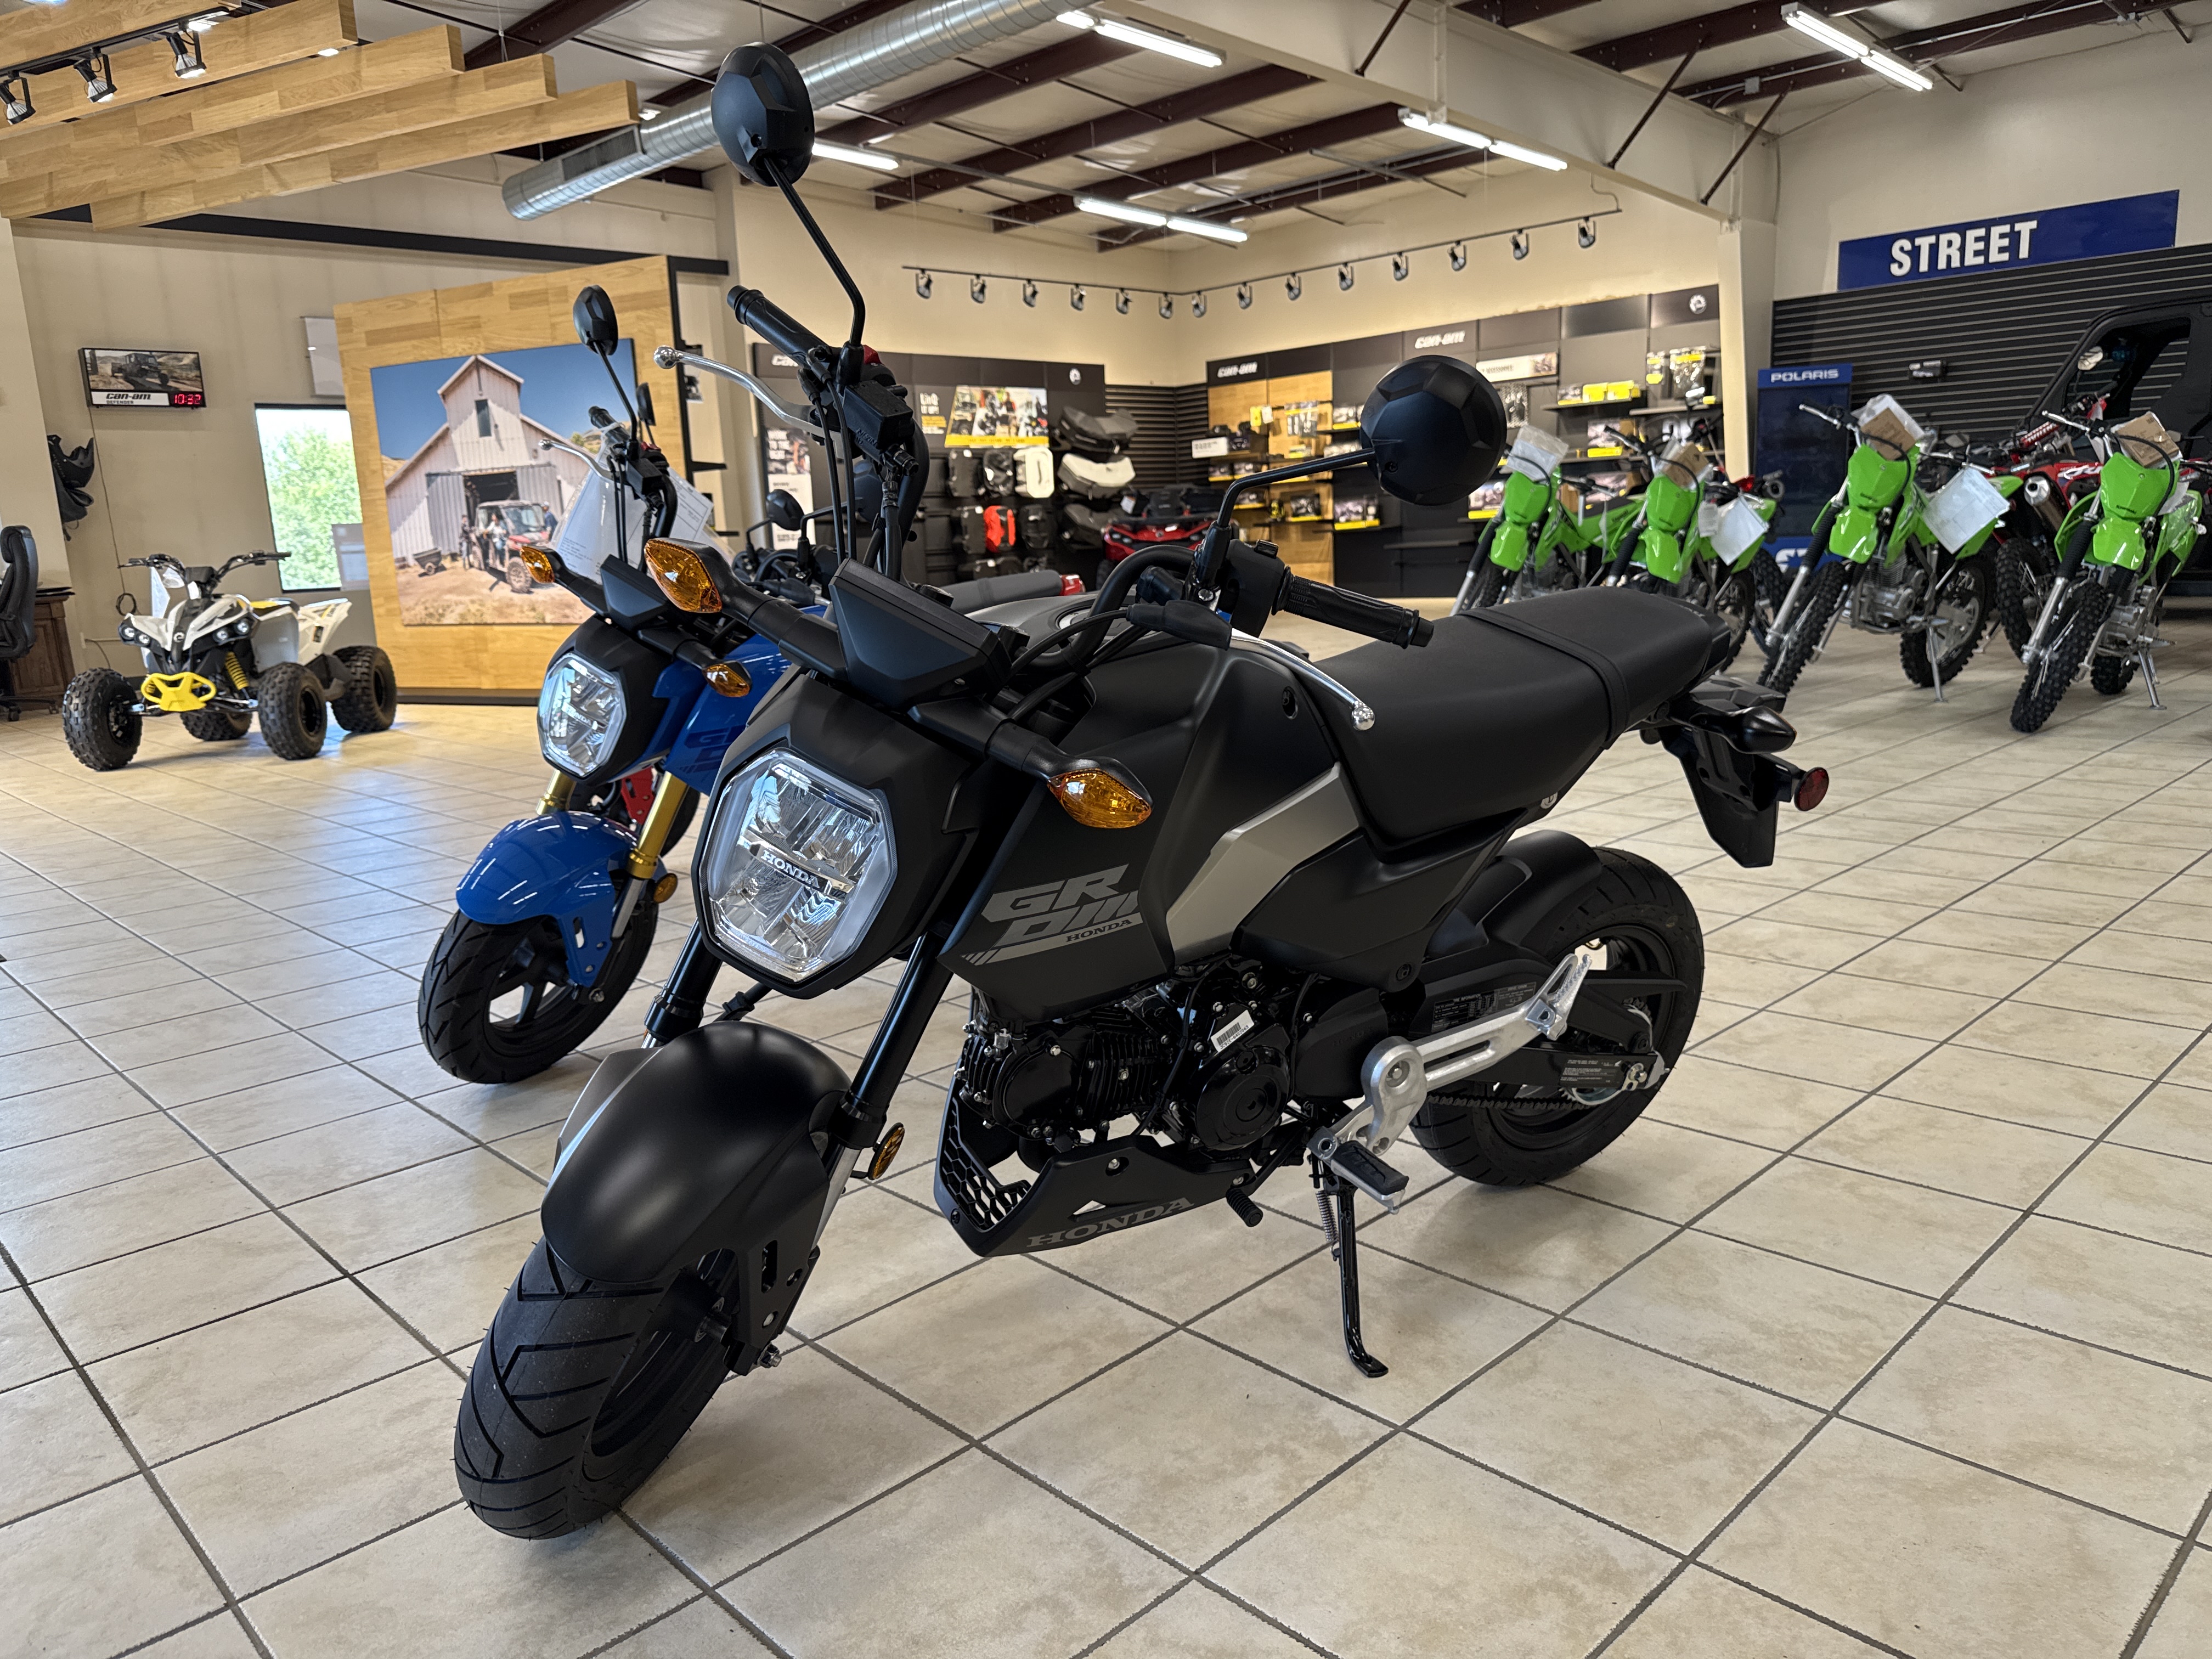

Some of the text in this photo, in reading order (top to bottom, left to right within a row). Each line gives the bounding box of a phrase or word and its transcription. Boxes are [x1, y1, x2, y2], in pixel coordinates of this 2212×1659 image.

[1890, 220, 2037, 276] STREET
[1771, 368, 1839, 383] POLARIS
[760, 849, 821, 889] HONDA
[981, 864, 1129, 923] GR
[1065, 918, 1132, 943] HONDA
[1027, 1198, 1195, 1248] HONDA
